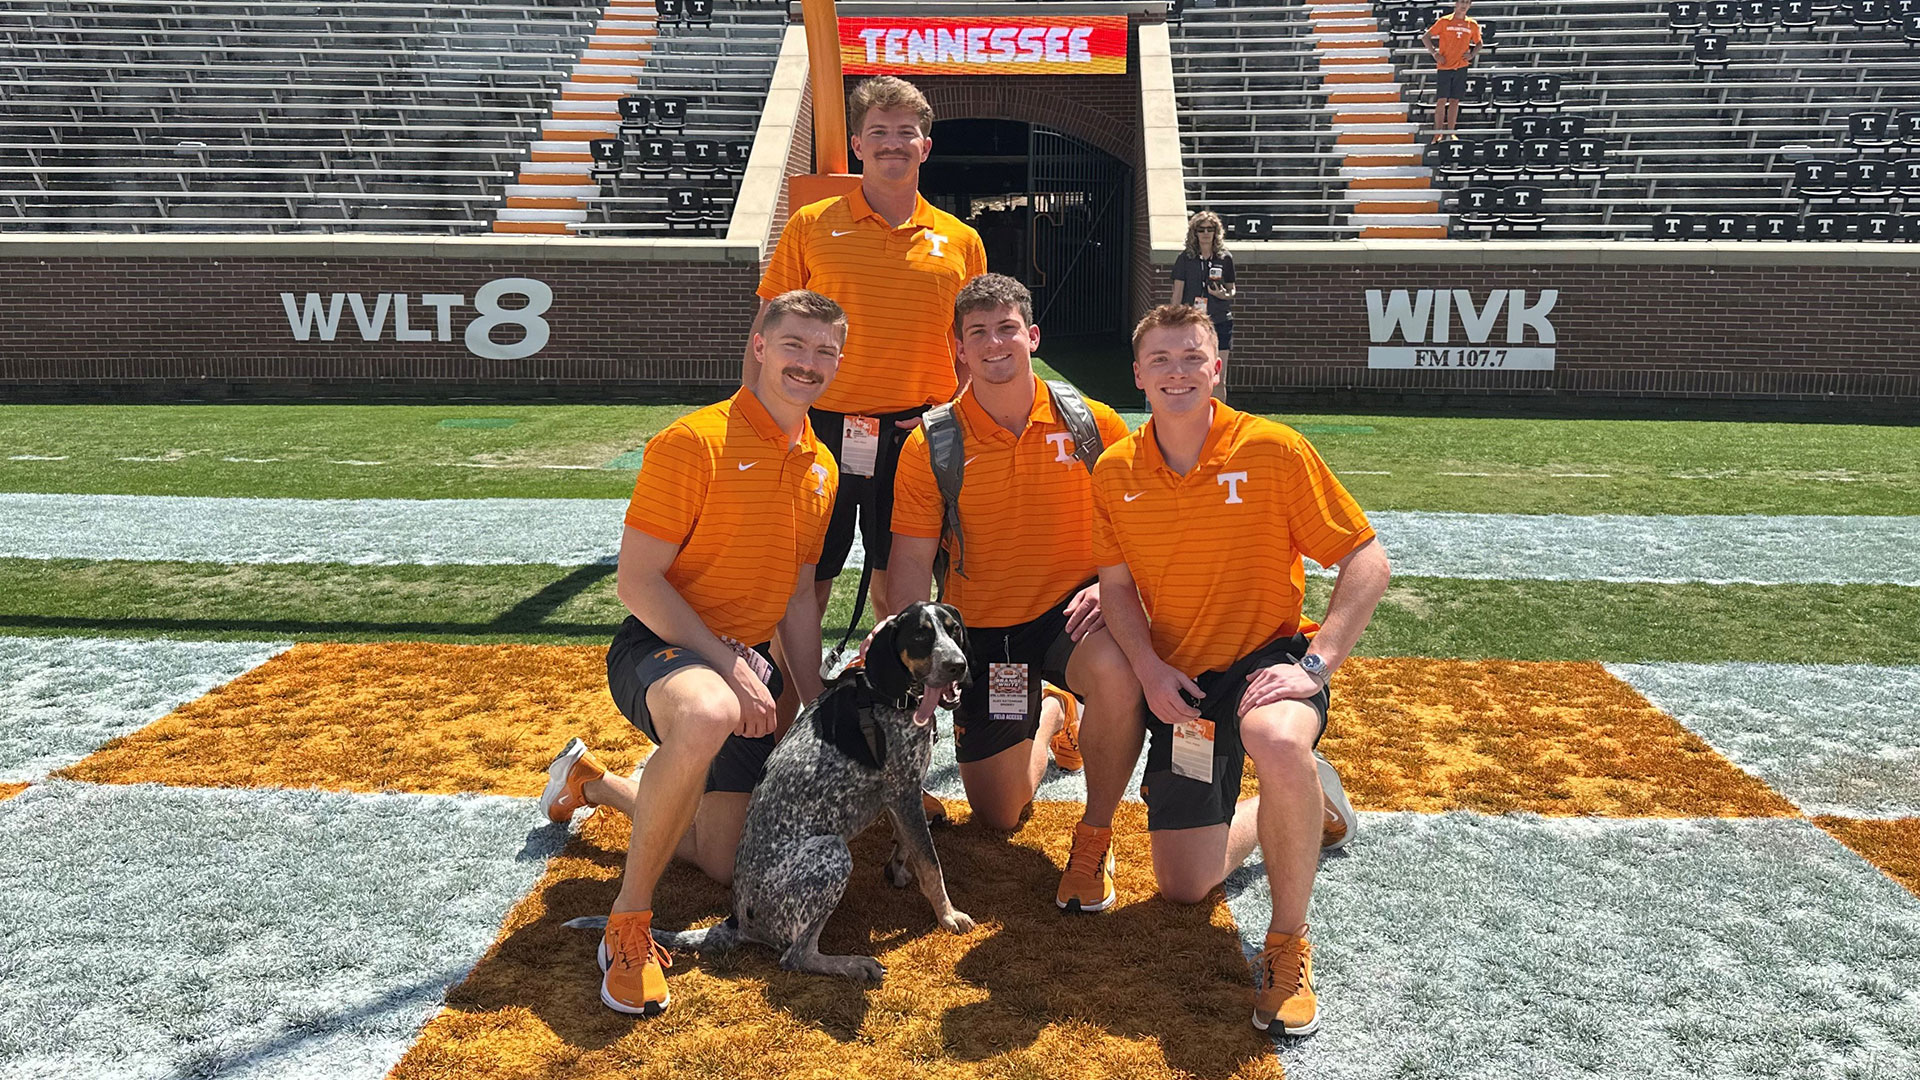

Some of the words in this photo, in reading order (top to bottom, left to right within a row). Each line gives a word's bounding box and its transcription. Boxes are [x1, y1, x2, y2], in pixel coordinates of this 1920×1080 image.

[664, 1, 674, 11] T
[694, 1, 704, 11] T
[1677, 4, 1690, 16] T
[1716, 4, 1728, 15] T
[1751, 3, 1762, 14] T
[1790, 2, 1801, 13] T
[1862, 1, 1874, 12] T
[1900, 0, 1911, 11] T
[1398, 10, 1409, 21] T
[1433, 10, 1443, 20] T
[858, 27, 1093, 64] TENNESSEE
[1705, 39, 1716, 50] T
[1466, 81, 1476, 92] T
[1502, 80, 1514, 92] T
[1538, 79, 1550, 91] T
[628, 101, 640, 113] T
[665, 102, 677, 114] T
[1523, 121, 1536, 133] T
[1561, 121, 1573, 133] T
[1861, 118, 1875, 130] T
[600, 143, 614, 156] T
[650, 143, 663, 155] T
[696, 144, 708, 156] T
[737, 145, 749, 157] T
[1450, 145, 1463, 157] T
[1495, 144, 1508, 157] T
[1535, 144, 1548, 156] T
[1580, 143, 1593, 156] T
[1808, 166, 1822, 179] T
[1860, 165, 1874, 178] T
[1908, 165, 1920, 178] T
[679, 192, 692, 204] T
[1471, 193, 1485, 206] T
[1516, 192, 1529, 205] T
[1247, 220, 1260, 233] T
[1665, 219, 1680, 233] T
[1719, 219, 1734, 233] T
[1769, 219, 1784, 233] T
[1818, 219, 1833, 233] T
[1871, 219, 1886, 233] T
[924, 230, 949, 257] T
[1365, 290, 1558, 343] WIVK
[1415, 350, 1450, 367] FM
[1457, 350, 1507, 367] 107.7
[1046, 432, 1074, 462] T
[812, 463, 828, 496] T
[1217, 471, 1248, 504] T
[653, 647, 682, 662] T
